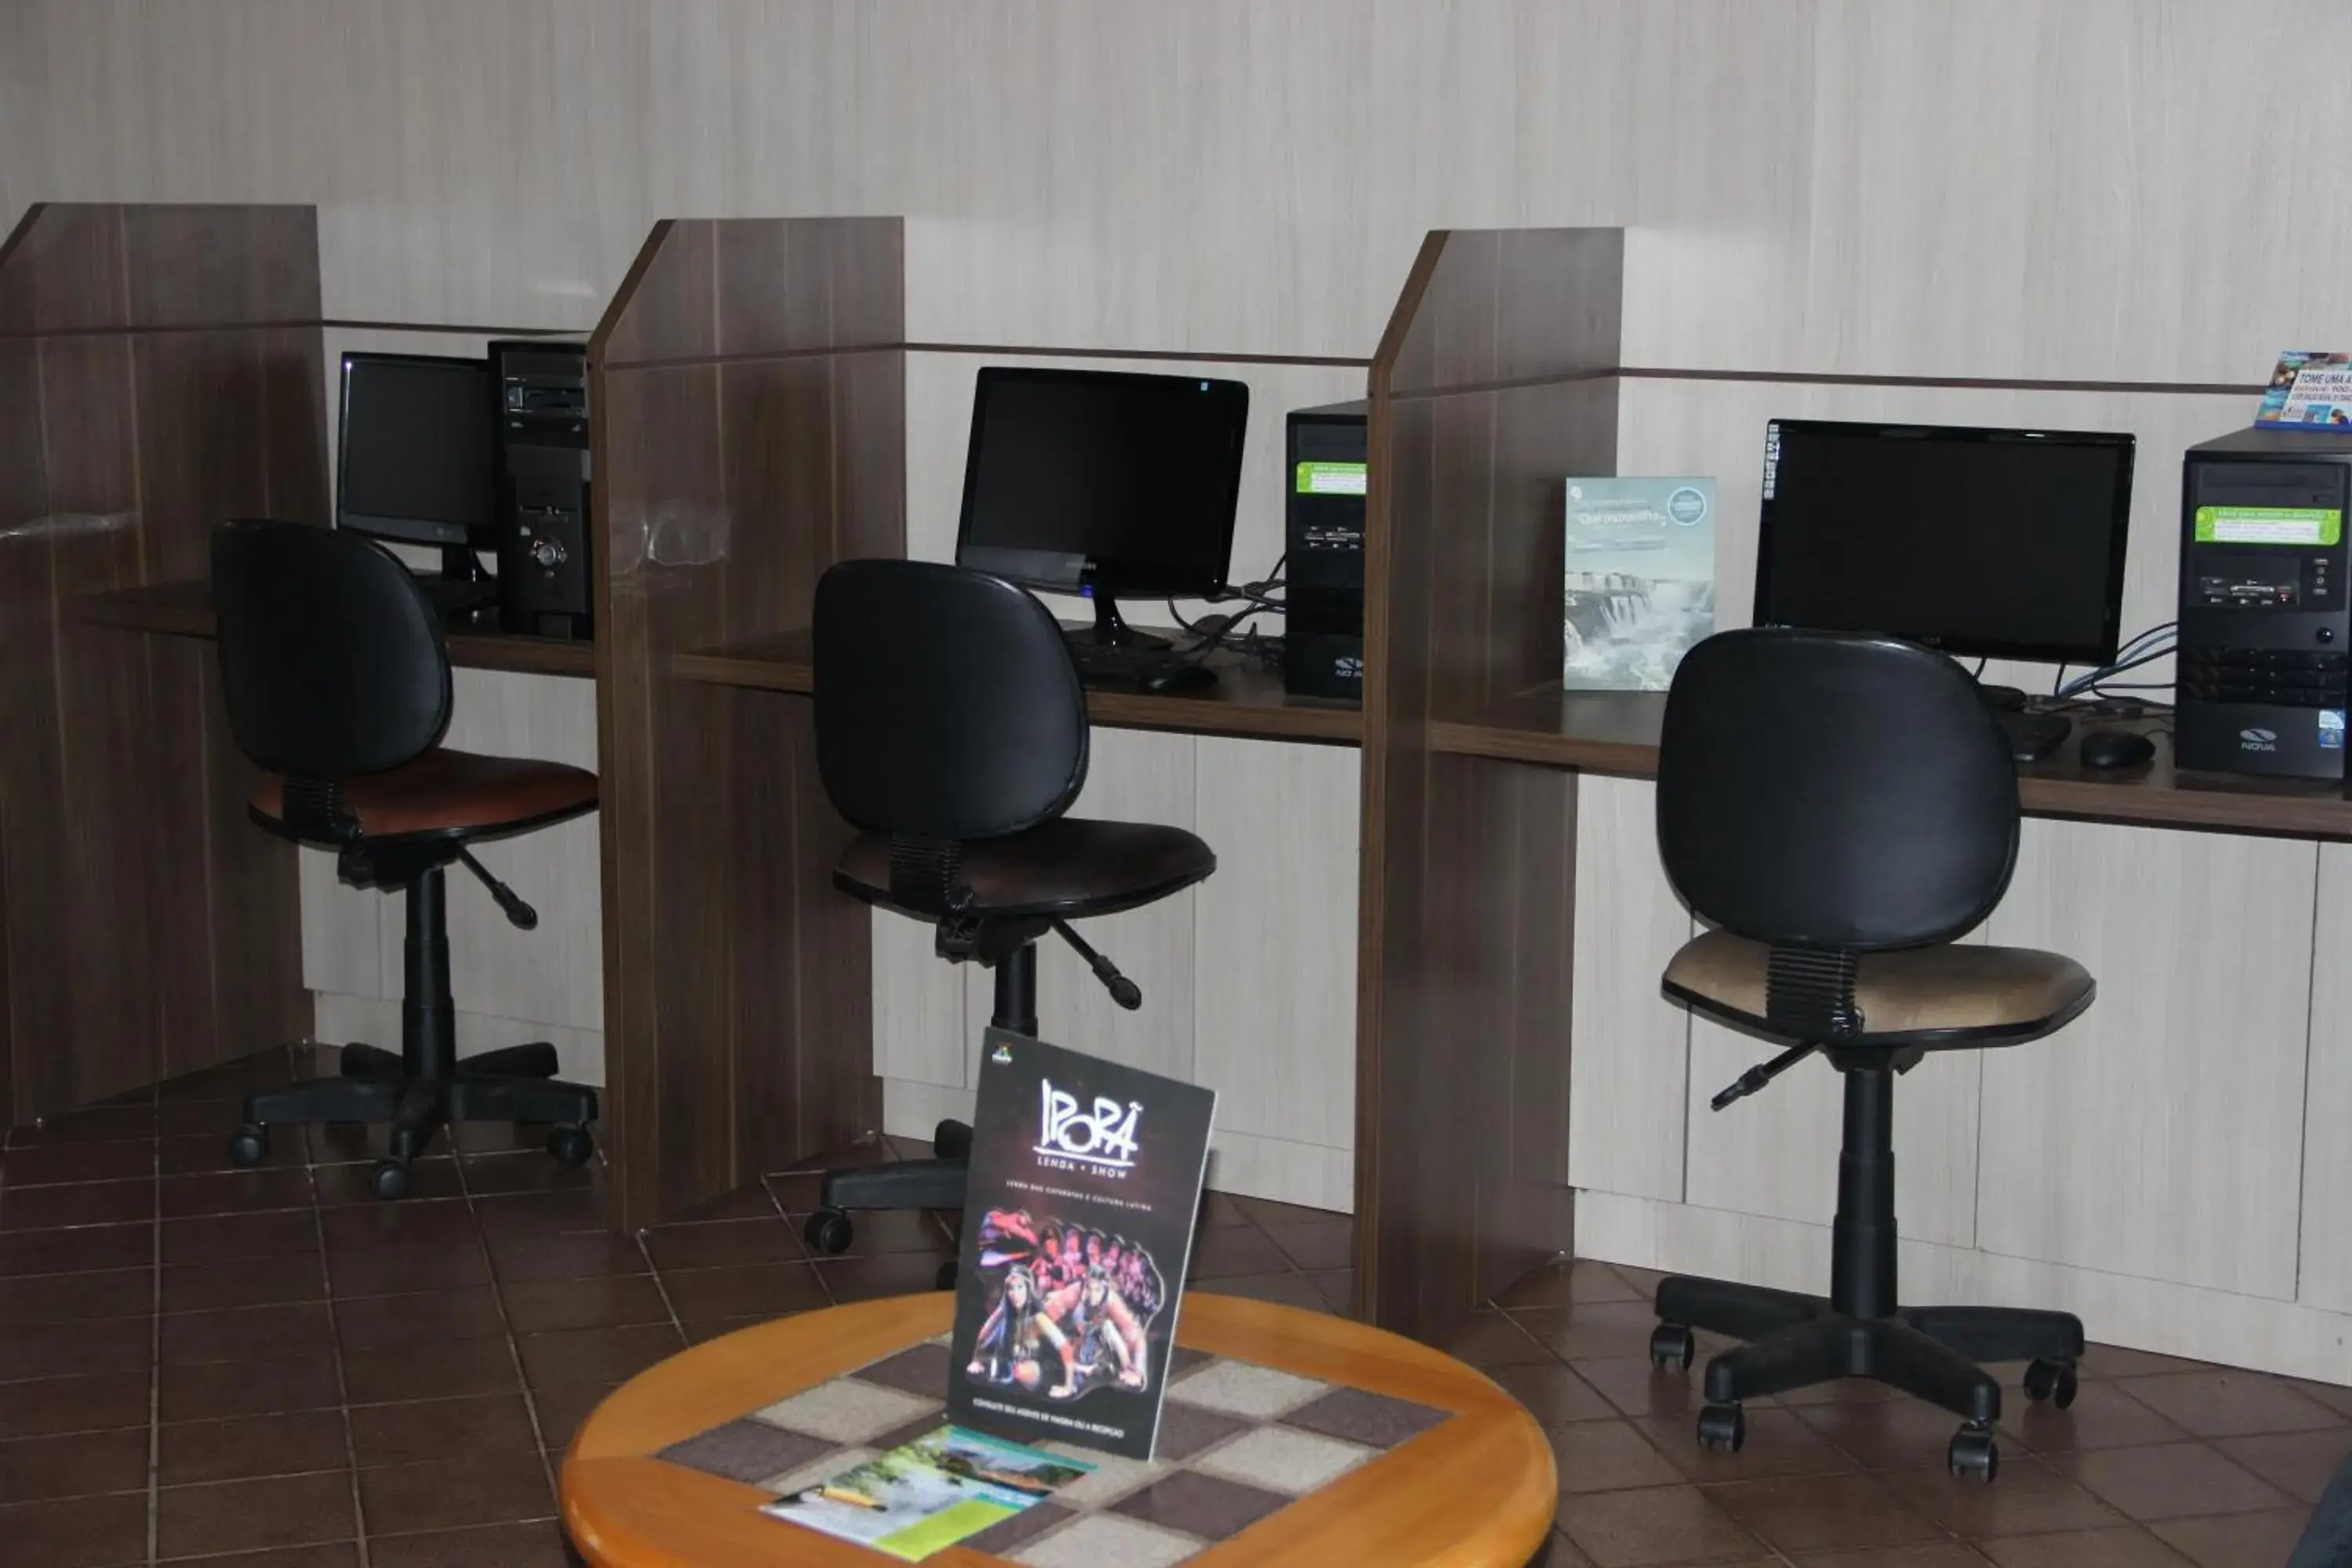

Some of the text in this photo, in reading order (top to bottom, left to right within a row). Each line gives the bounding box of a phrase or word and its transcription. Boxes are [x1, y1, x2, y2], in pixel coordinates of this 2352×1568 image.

[2299, 372, 2325, 383] TOME
[1036, 1156, 1127, 1180] LENDA SHOW
